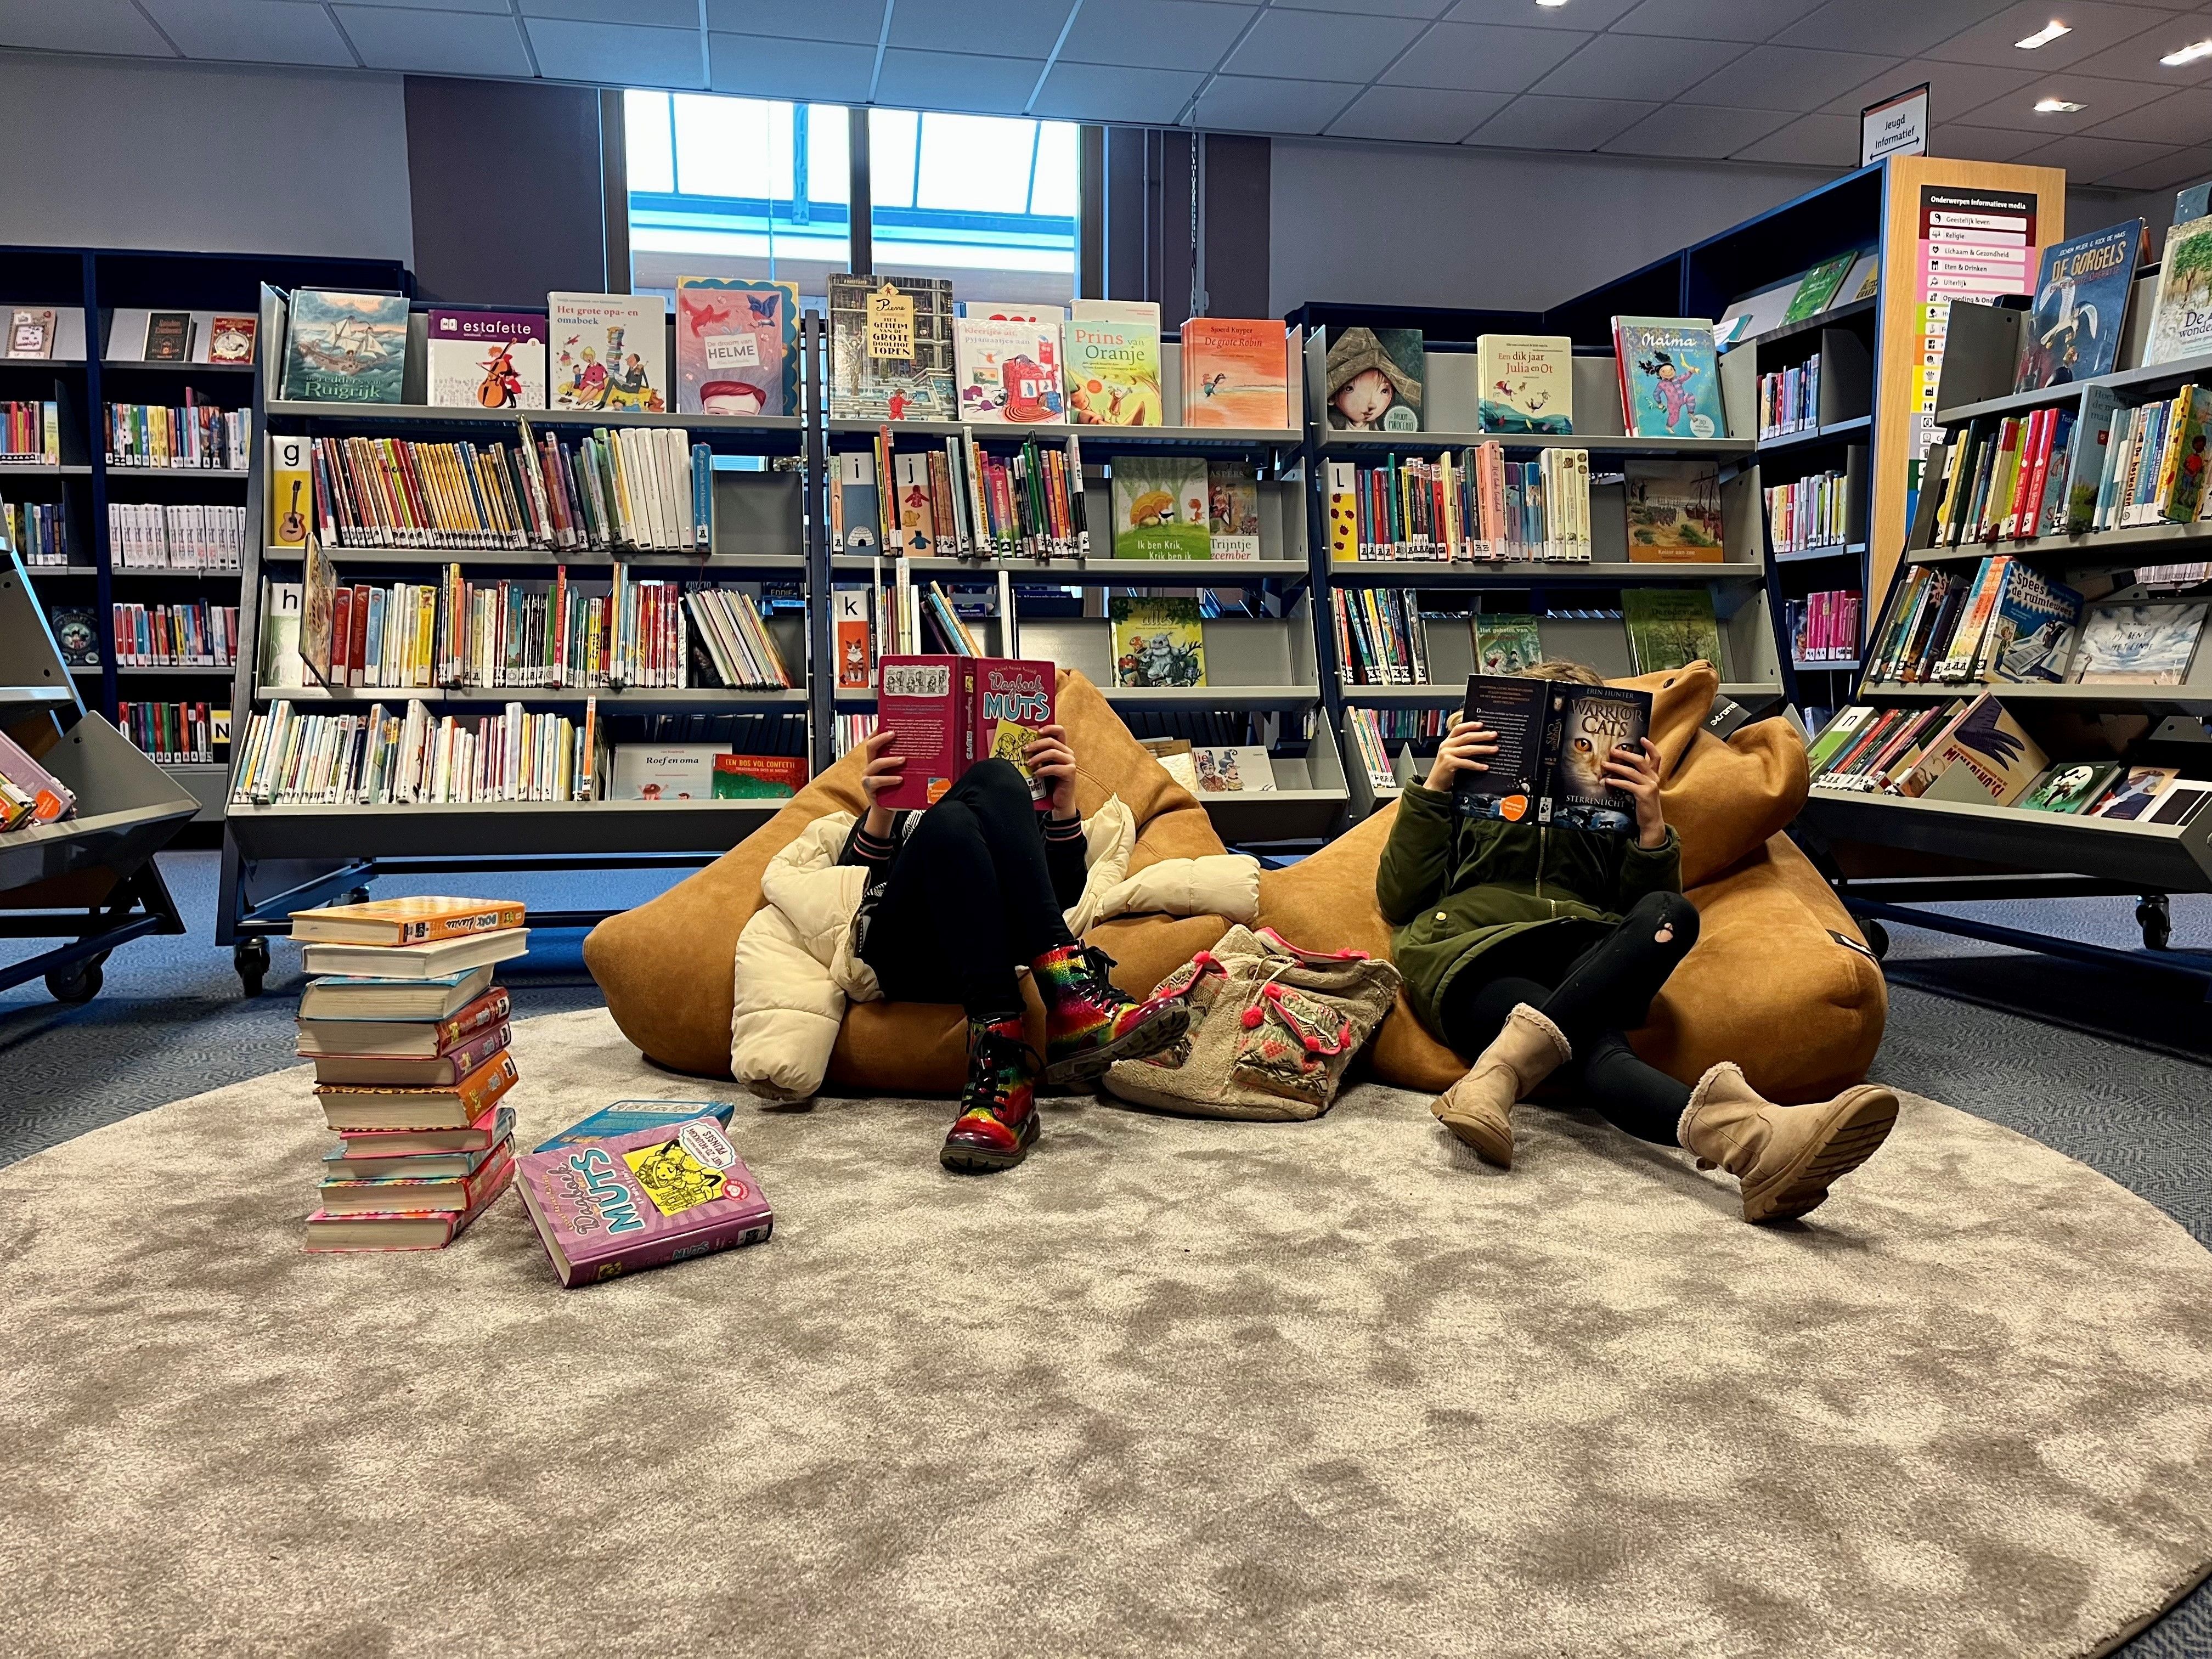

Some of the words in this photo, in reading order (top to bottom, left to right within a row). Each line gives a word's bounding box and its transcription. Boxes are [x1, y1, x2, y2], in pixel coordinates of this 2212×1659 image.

[1885, 114, 1905, 131] Jeugd
[1875, 125, 1915, 149] Informatief
[1931, 196, 1970, 206] Onderwerpen
[1946, 217, 1974, 225] Geestelijk
[1944, 279, 1966, 287] Uiterlijk
[876, 299, 905, 311] Pierre
[464, 320, 531, 334] estafette
[2184, 312, 2204, 328] De
[873, 333, 909, 342] GROTE
[965, 328, 1001, 336] Kleertjes
[1075, 329, 1124, 345] Prins
[1205, 337, 1216, 346] De
[1217, 338, 1237, 349] grote
[1239, 338, 1262, 347] Robin
[1641, 333, 1697, 347] Naima
[708, 346, 755, 359] HELME
[873, 347, 910, 356] TOREN
[1086, 345, 1145, 365] Oranje
[1513, 352, 1526, 360] dik
[1528, 352, 1545, 363] jaar
[1506, 362, 1530, 374] Julia
[1541, 364, 1553, 374] Ot
[303, 381, 381, 400] Ruigrijk
[284, 444, 300, 467] g
[855, 459, 859, 478] i
[909, 458, 913, 483] j
[1337, 468, 1345, 488] L
[997, 490, 1006, 517] superdikke
[1138, 540, 1144, 549] Ik
[1148, 540, 1161, 549] ben
[1164, 540, 1183, 551] Krik,
[1211, 539, 1251, 554] Trijntje
[1149, 551, 1169, 560] Krik
[1170, 551, 1182, 560] ben
[1184, 551, 1192, 560] ik
[2017, 573, 2045, 595] Spees
[283, 589, 297, 610] h
[845, 597, 857, 616] k
[2012, 586, 2022, 603] de
[2025, 592, 2072, 617] ruimtewees
[1141, 611, 1172, 625] alles
[989, 671, 1044, 700] Dagboek
[1587, 687, 1603, 696] ERIN
[1605, 690, 1634, 699] HUNTER
[983, 692, 1051, 721] MUTS
[1571, 699, 1644, 723] WARRIOR
[1582, 716, 1629, 737] CATS
[1842, 715, 1858, 726] n
[216, 723, 229, 737] N
[646, 756, 665, 766] Roef
[766, 760, 795, 769] CONFETTI
[1566, 794, 1625, 809] STERRENLICHT
[478, 912, 499, 928] DORK
[702, 1130, 727, 1155] PRINSES
[570, 1147, 646, 1236] MUTS
[628, 1183, 642, 1197] WAS
[546, 1163, 601, 1235] Dagboek
[672, 1242, 709, 1262] MUTS
